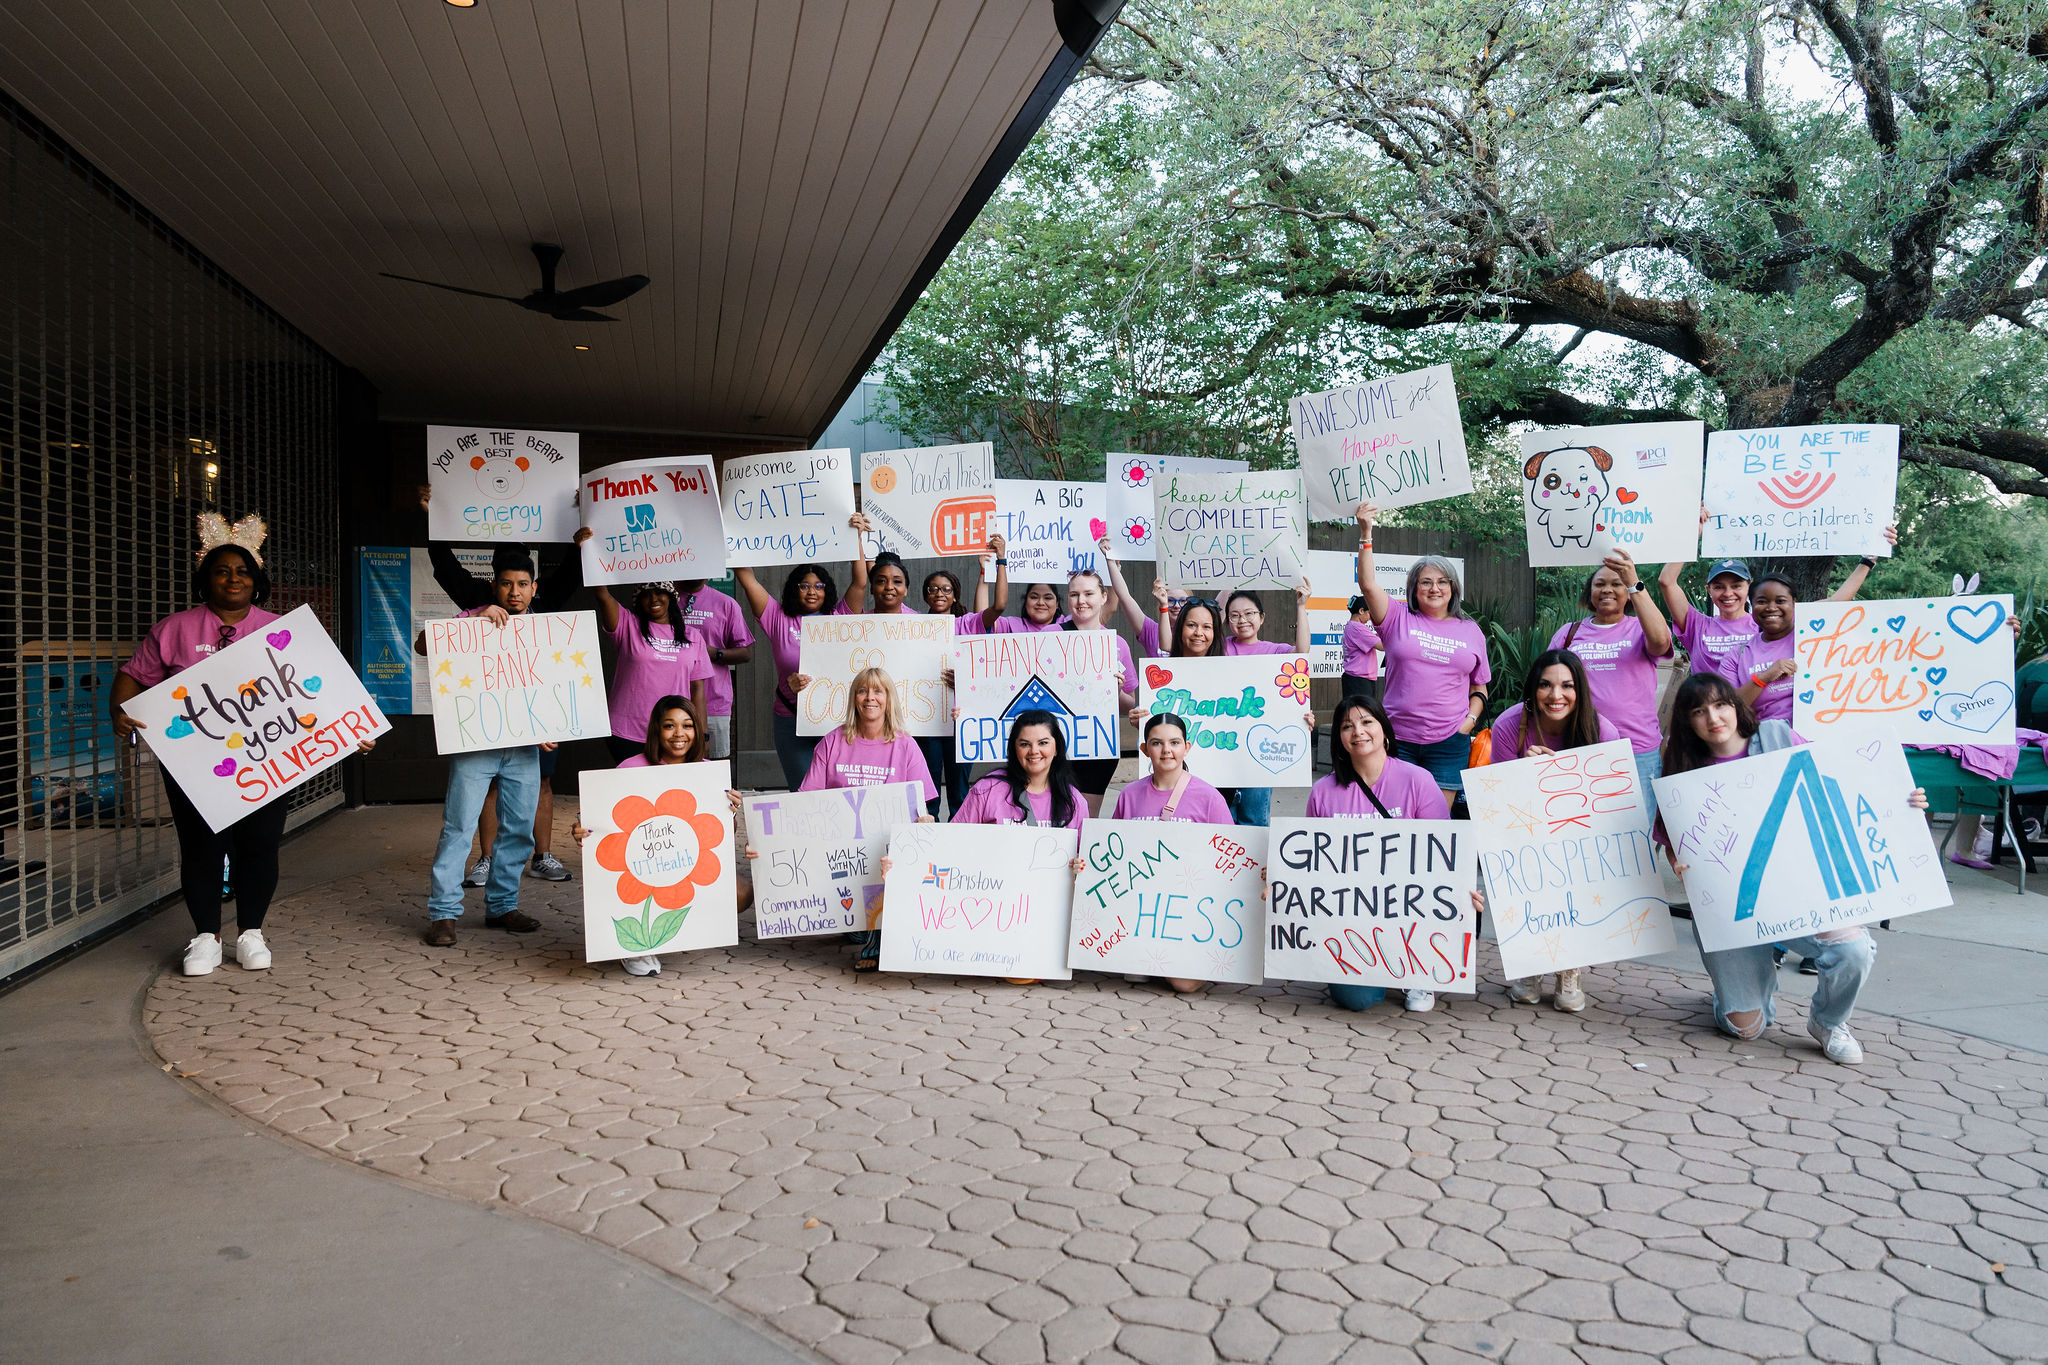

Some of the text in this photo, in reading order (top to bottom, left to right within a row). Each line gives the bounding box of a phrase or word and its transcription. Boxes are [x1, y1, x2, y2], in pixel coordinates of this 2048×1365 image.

[1299, 380, 1402, 440] AWESOME
[432, 432, 565, 474] YOU ARE THE BEARY
[484, 448, 515, 458] BEST
[1341, 433, 1413, 463] Harper
[1647, 447, 1666, 459] PCI
[1738, 430, 1871, 452] YOU ARE THE
[725, 455, 839, 481] awesome job
[864, 452, 891, 471] Smile
[1743, 451, 1841, 474] BEST
[587, 468, 709, 503] Thank You!
[1034, 487, 1084, 508] A BIG
[1159, 476, 1216, 511] keep
[1219, 478, 1252, 504] it
[734, 480, 825, 521] GATE
[463, 505, 542, 533] energy
[1168, 506, 1288, 532] COMPLETE
[1602, 506, 1653, 525] Thank
[1708, 506, 1874, 530] Texas Children's
[466, 522, 513, 539] ogre
[605, 528, 683, 553] JERICHO
[1611, 525, 1645, 544] You
[1754, 532, 1830, 554] Hospital
[1006, 547, 1044, 559] routman
[1190, 534, 1257, 556] CARE
[370, 559, 401, 567] ATENCIÓN
[598, 547, 696, 573] Woodworks
[1032, 559, 1059, 570] locke
[1179, 556, 1293, 579] MEDICAL
[805, 619, 876, 644] WHOOP
[1325, 634, 1337, 644] ALL
[1798, 605, 1945, 669] Thank
[849, 647, 885, 674] GO
[960, 634, 1112, 679] THANK YOU!
[1312, 663, 1334, 673] WORN
[1324, 651, 1338, 660] PPE
[1580, 651, 1619, 660] VOLUNTEER
[481, 648, 544, 691] BANK
[180, 646, 317, 741] thank
[1150, 685, 1266, 720] Thank
[1958, 696, 1995, 714] Strive
[242, 706, 318, 762] you
[1258, 737, 1297, 755] CSAT
[235, 704, 379, 803] SILVESTRI
[1259, 753, 1294, 763] Solutions
[836, 763, 860, 773] WALK
[1534, 753, 1592, 835] ROCK
[637, 820, 676, 842] Thank
[1677, 780, 1725, 856] Thank
[642, 839, 675, 860] you
[1088, 832, 1124, 872] GO
[1208, 833, 1260, 871] KEEP IT
[1279, 830, 1457, 876] GRIFFIN
[1857, 793, 1900, 889] A & M
[632, 848, 695, 877] UT Health
[769, 845, 867, 888] 5K WALK
[828, 858, 869, 876] WITH ME
[1085, 839, 1180, 909] TEAM
[1214, 855, 1242, 882] UP!
[1483, 827, 1657, 900] PROSPERITY
[948, 866, 1004, 891] Bristow
[761, 895, 828, 915] Community
[836, 886, 852, 898] We
[1271, 880, 1464, 922] PARTNERS,
[759, 913, 838, 937] Health Choice
[844, 914, 855, 927] U
[918, 893, 957, 931] We
[1133, 892, 1244, 949] HESS
[1755, 899, 1875, 940] Alvarez & Marsal
[911, 936, 935, 962] You
[942, 948, 965, 962] are
[1078, 927, 1102, 950] YOU
[1096, 915, 1130, 958] ROCK!
[1270, 921, 1473, 985] INC. ROCKS!
